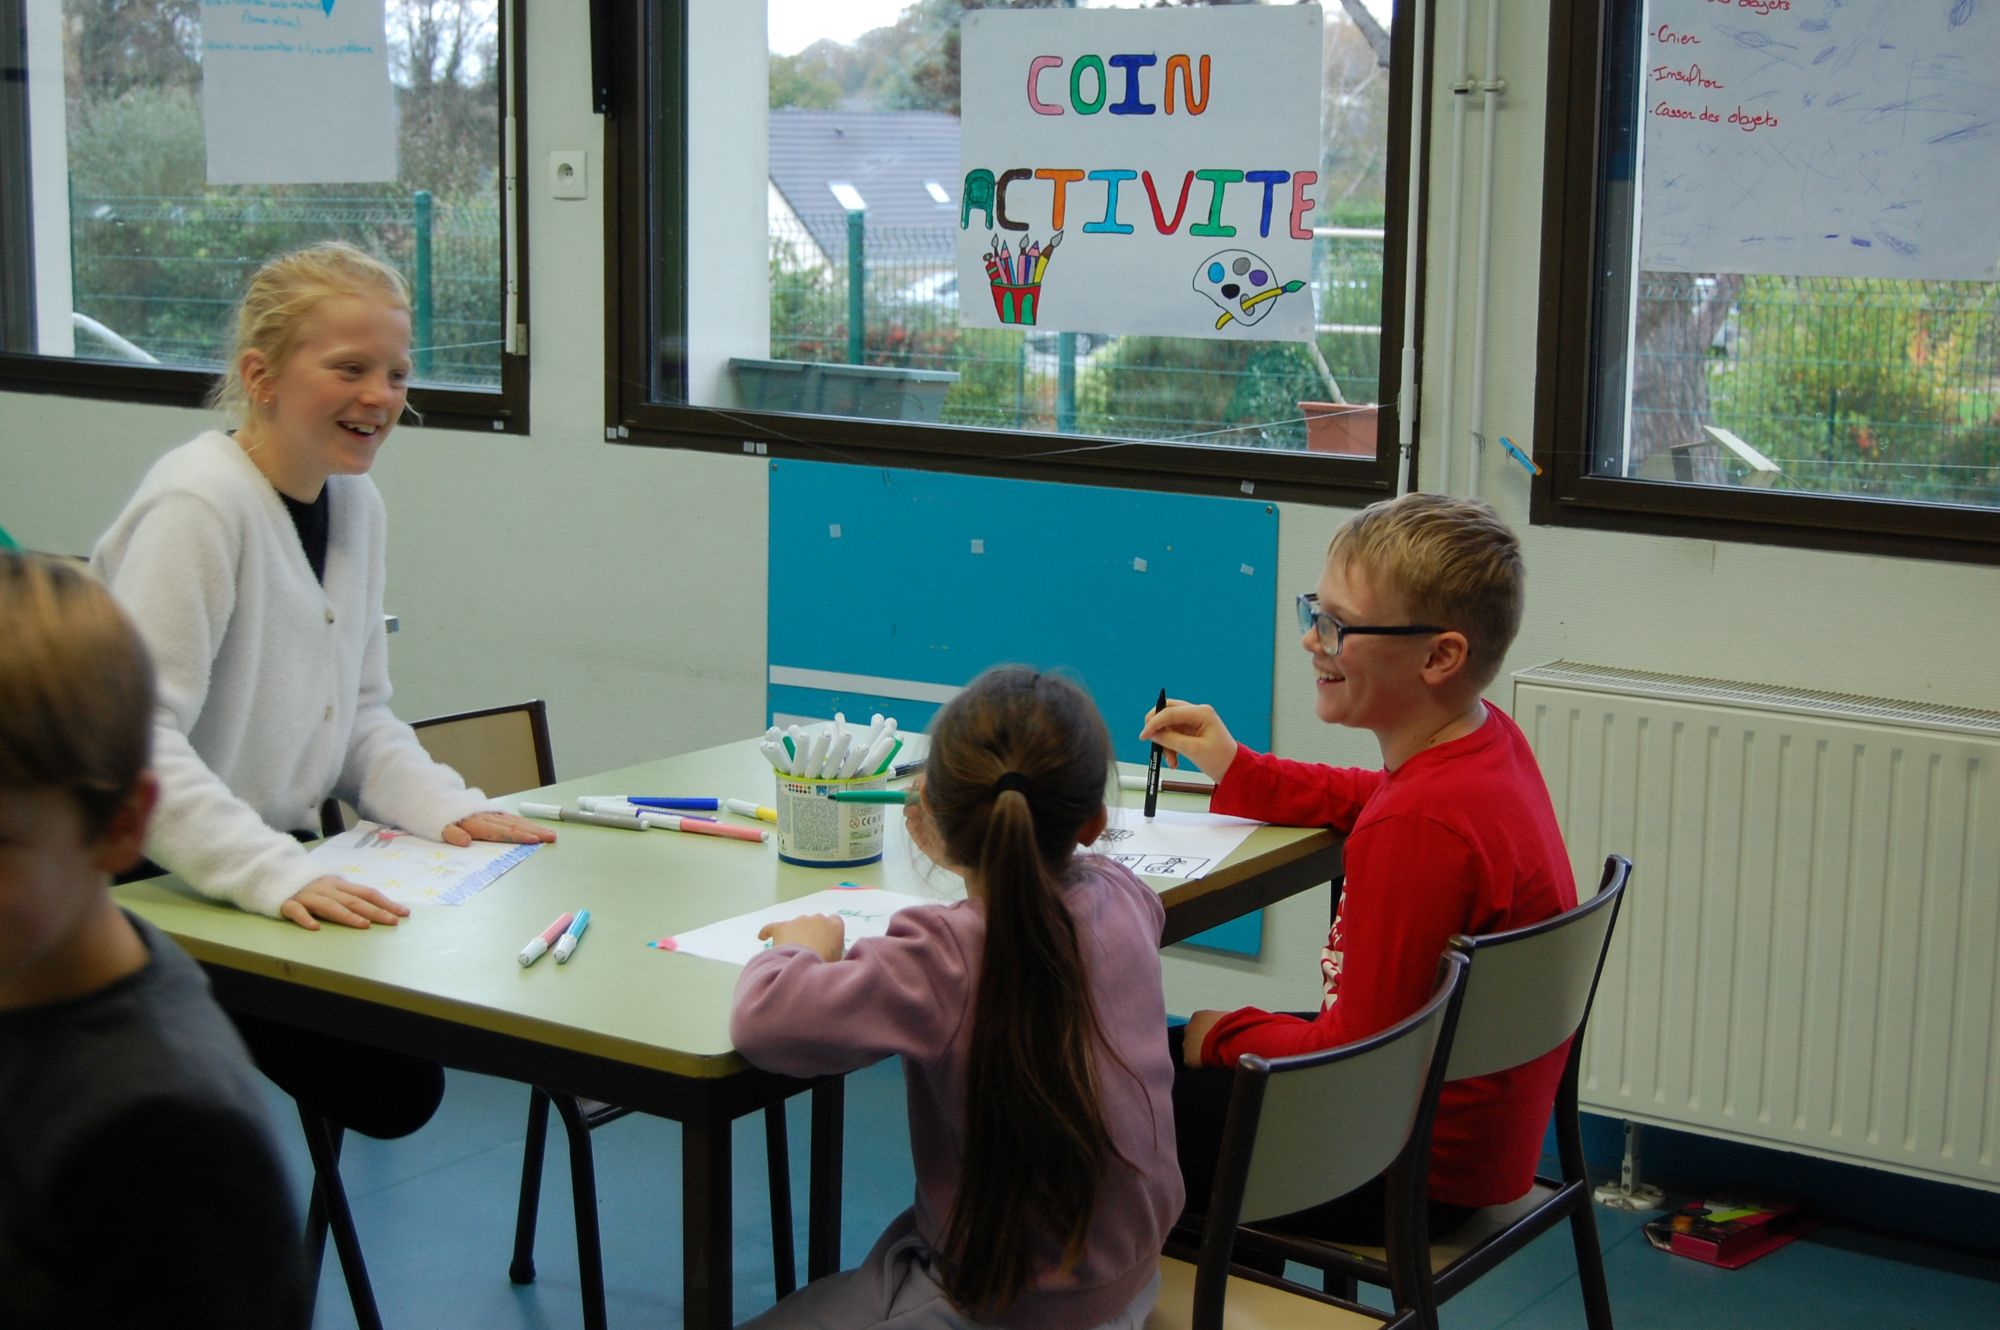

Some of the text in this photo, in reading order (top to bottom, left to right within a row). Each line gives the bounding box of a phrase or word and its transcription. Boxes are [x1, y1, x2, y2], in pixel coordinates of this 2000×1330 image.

[1027, 54, 1211, 116] COIN
[1655, 101, 1778, 132] Casser des objets
[960, 168, 1319, 240] ACTIVITE
